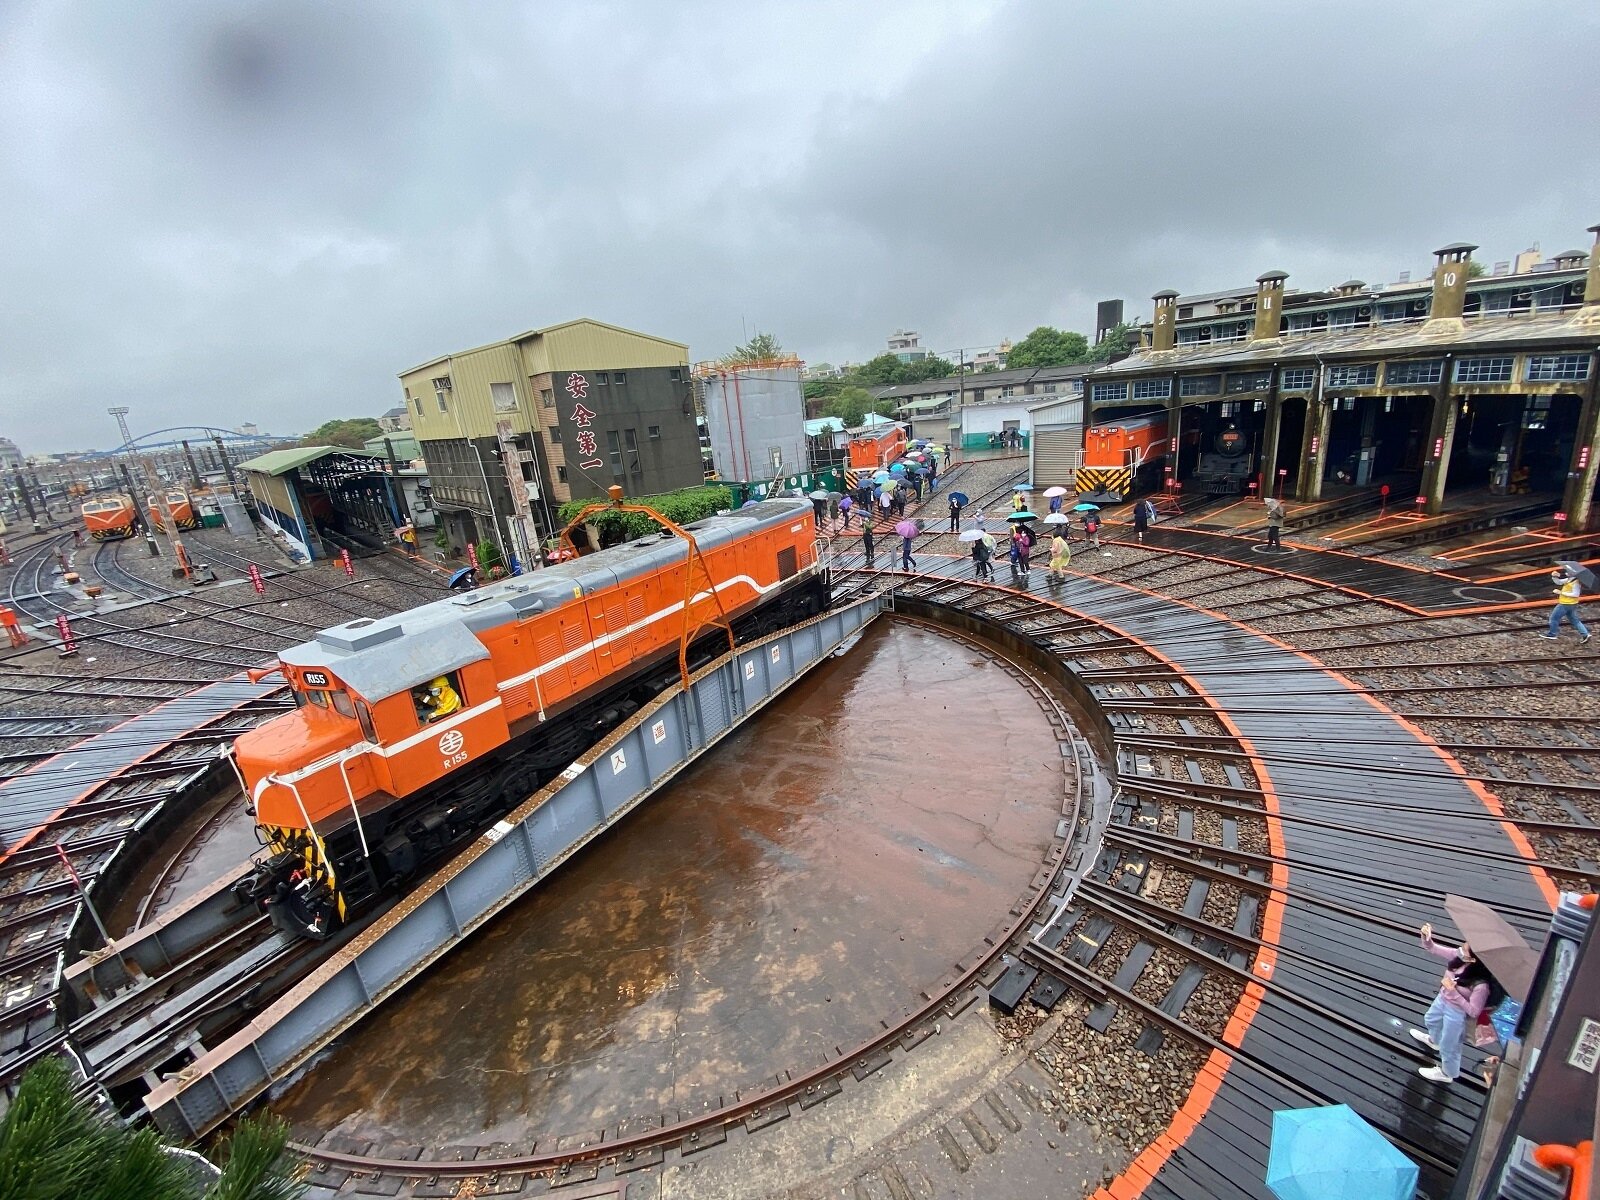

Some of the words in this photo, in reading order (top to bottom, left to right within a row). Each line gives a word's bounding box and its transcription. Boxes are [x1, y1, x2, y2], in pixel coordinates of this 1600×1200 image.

[1443, 272, 1456, 287] 10
[565, 372, 603, 469] 安全第一
[306, 673, 326, 685] R155
[614, 755, 625, 770] 入
[1125, 862, 1144, 875] 2
[5, 984, 34, 1008] 12
